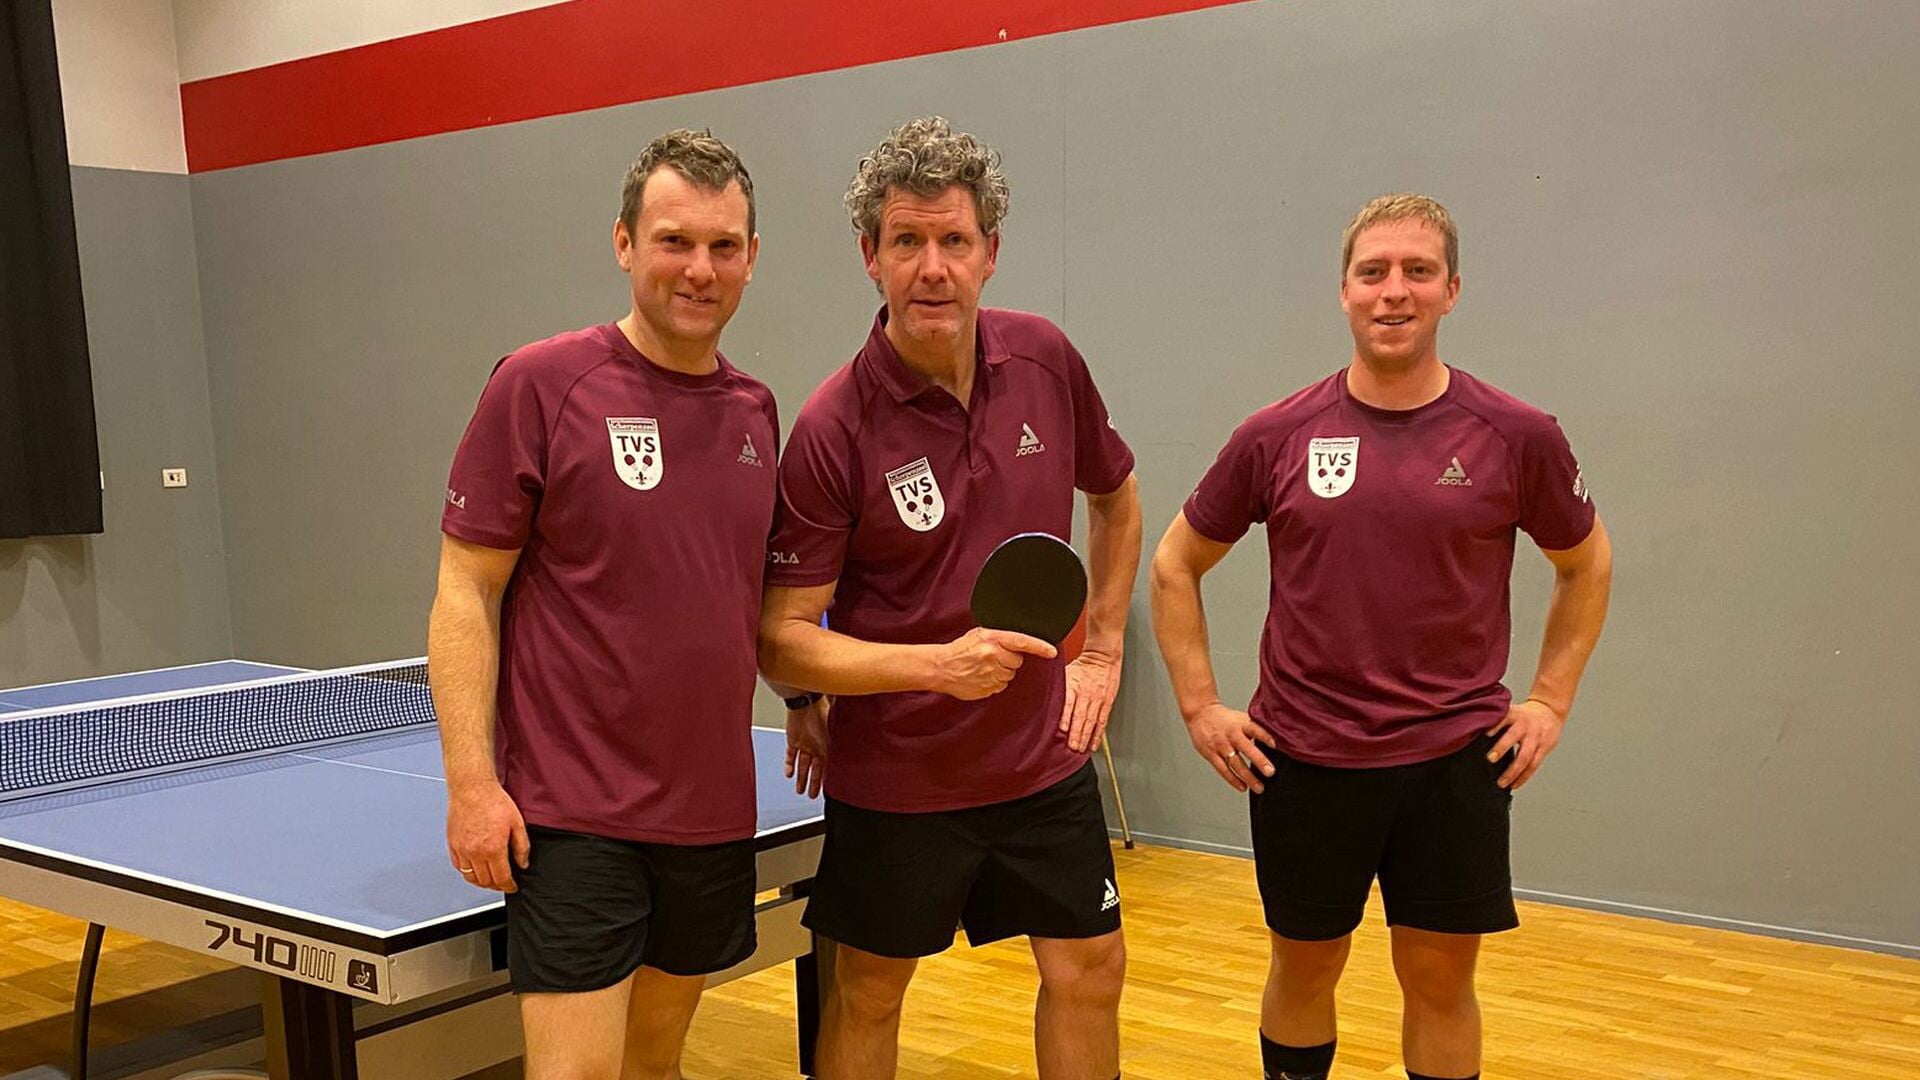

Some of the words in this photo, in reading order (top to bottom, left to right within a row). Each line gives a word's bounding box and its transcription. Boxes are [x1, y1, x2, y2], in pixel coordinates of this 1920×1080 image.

[616, 435, 656, 453] TVS
[1015, 443, 1046, 457] JOOLA
[1314, 452, 1352, 467] TVS
[895, 476, 933, 502] TVS
[1433, 476, 1473, 486] JOOLA
[204, 919, 298, 972] 740
